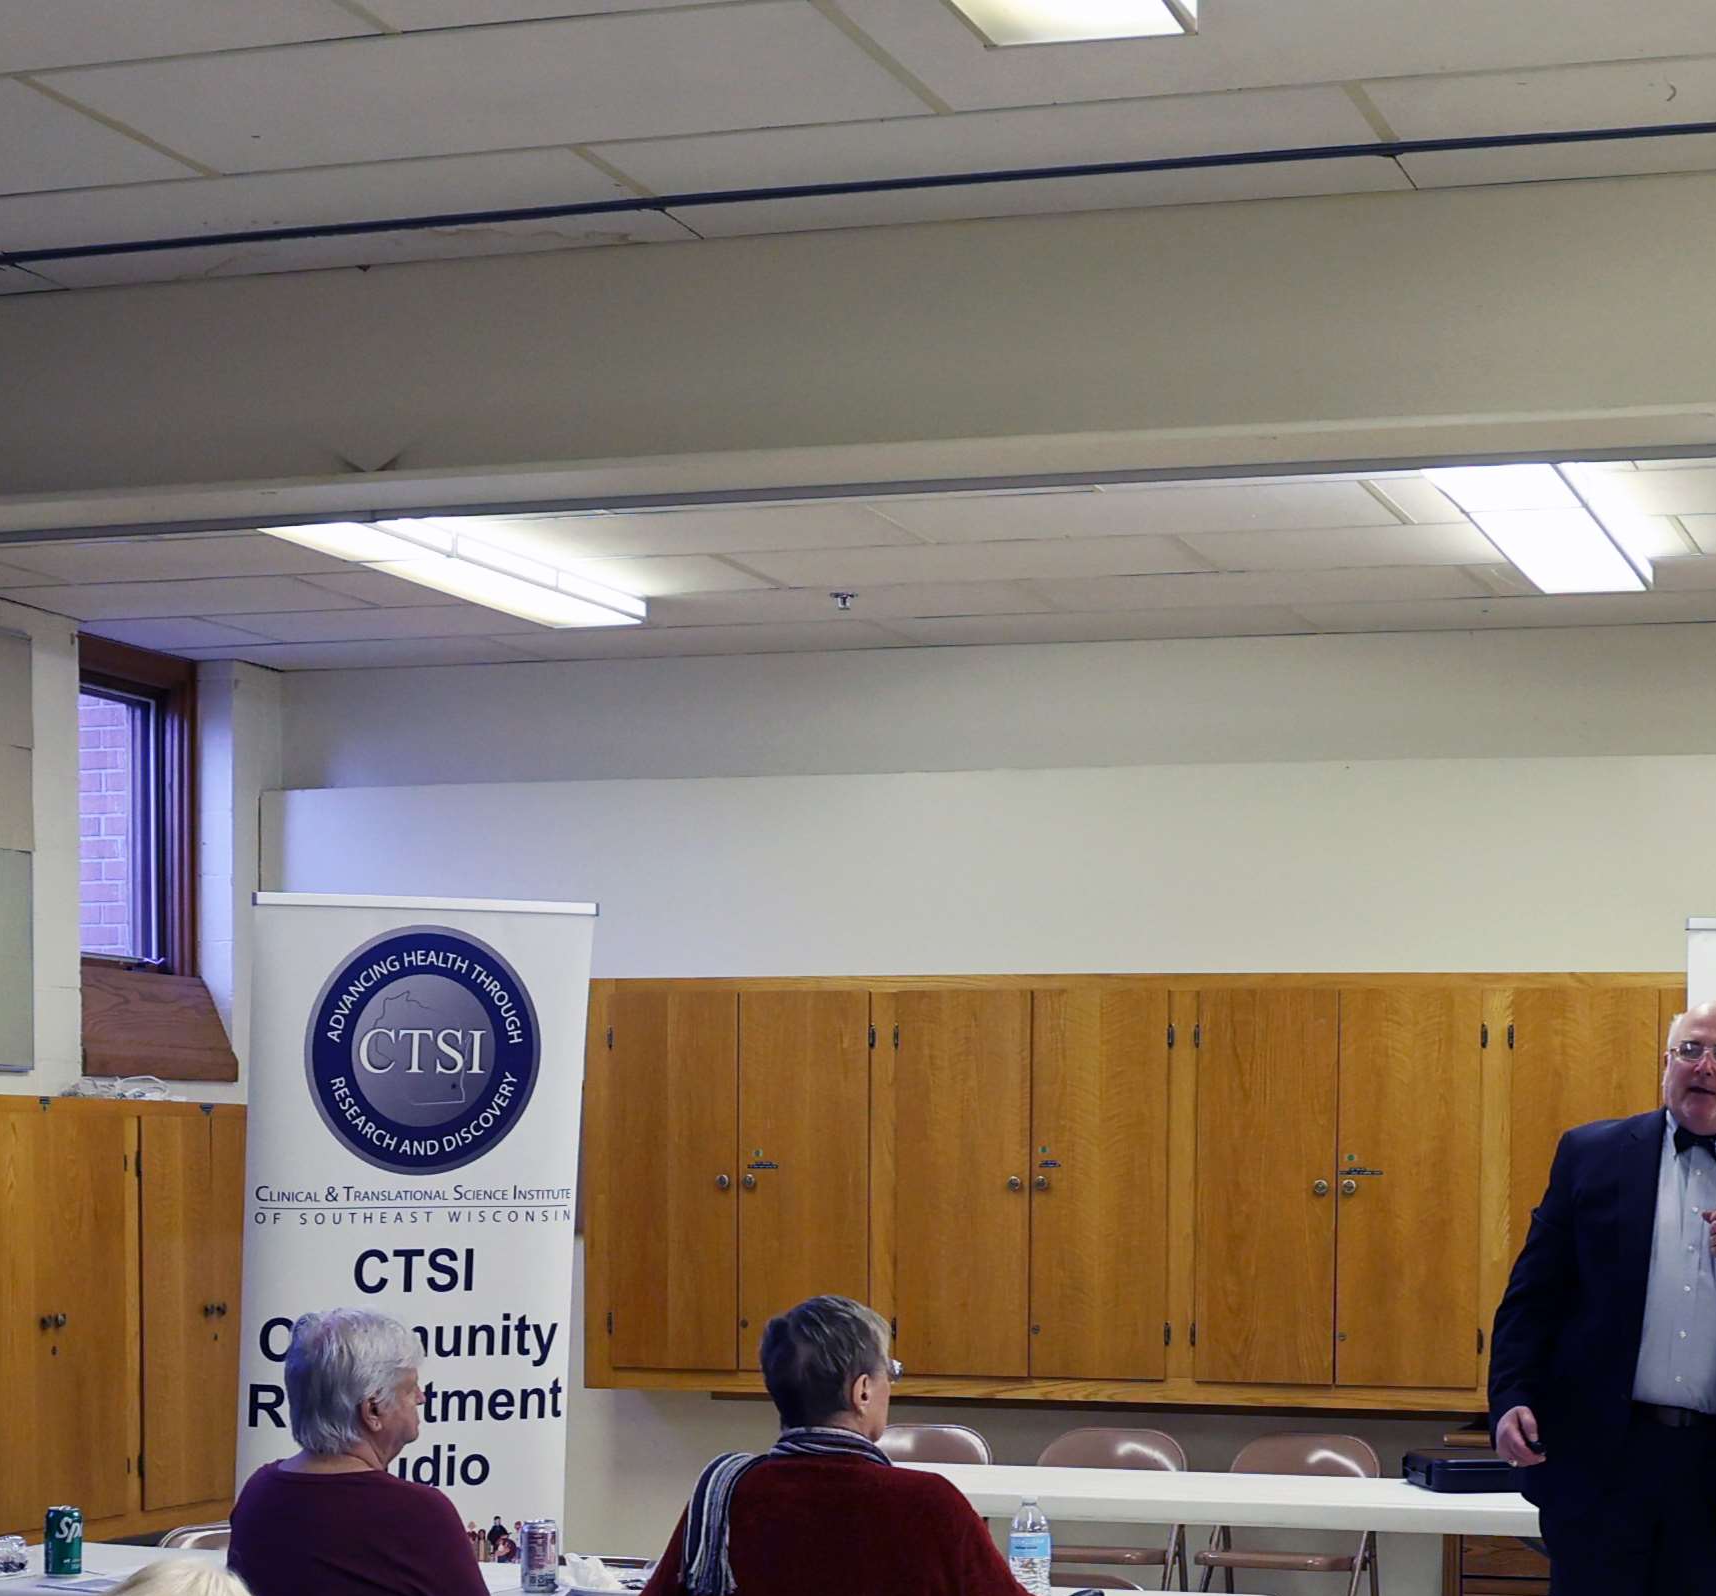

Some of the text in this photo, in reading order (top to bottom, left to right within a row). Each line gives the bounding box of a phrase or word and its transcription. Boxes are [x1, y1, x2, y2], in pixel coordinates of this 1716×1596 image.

[327, 950, 523, 1044] ADVANCING HEALTH THROUGH
[359, 1028, 486, 1074] CTSI
[331, 1071, 518, 1156] RESEARCH AND DISCOVERY
[254, 1209, 571, 1226] OF SOUTHEAST WISCONSIN
[324, 1185, 340, 1202] &
[353, 1247, 475, 1295] CTSI
[259, 1312, 558, 1367] Cunity
[248, 1377, 563, 1429] Rtment
